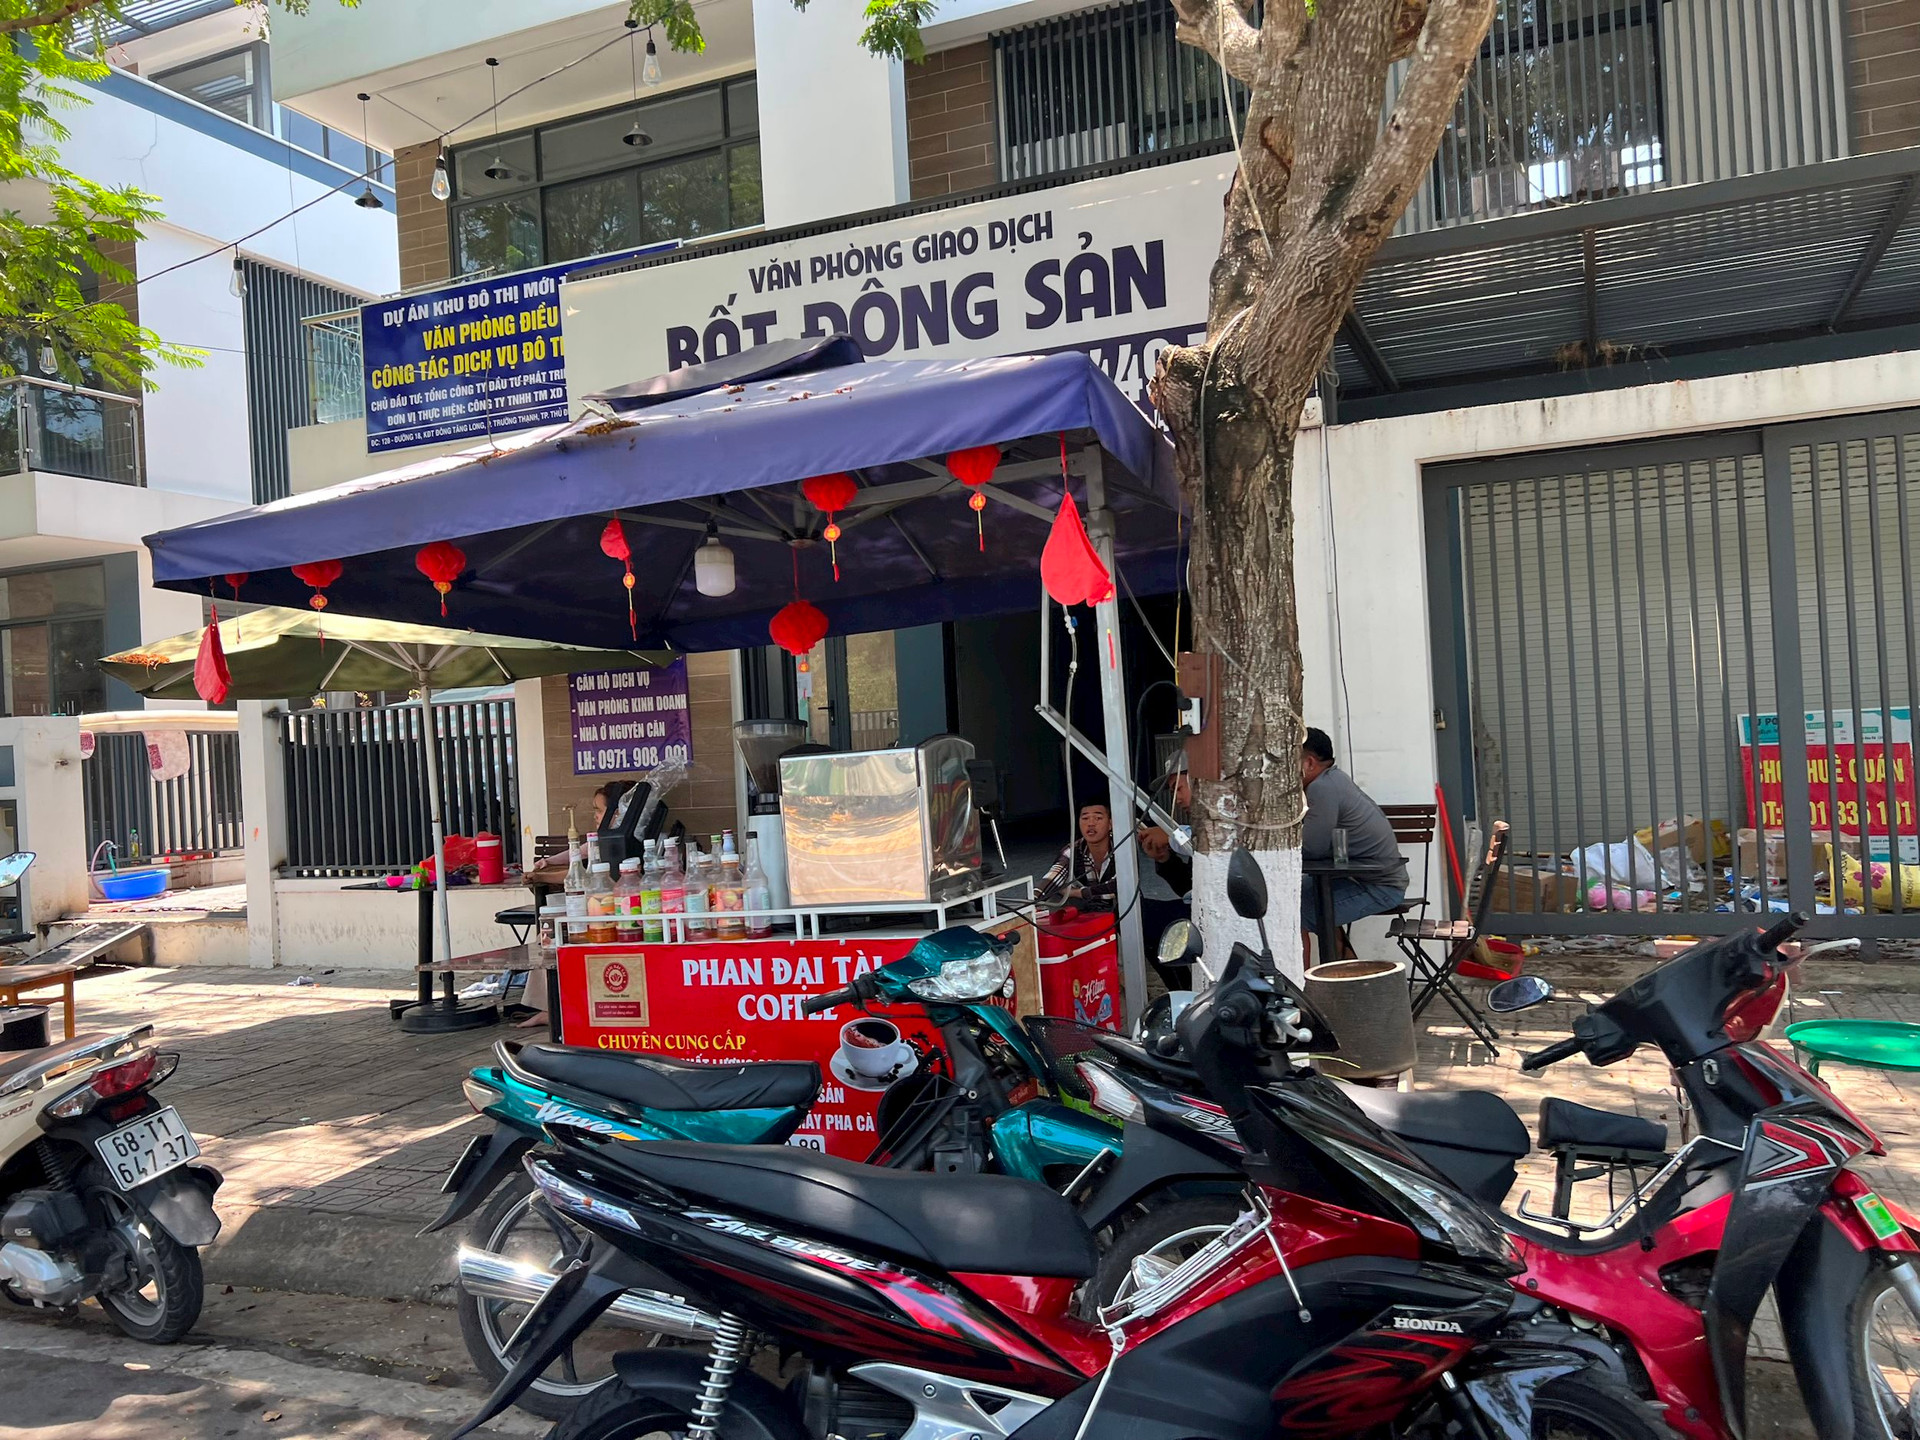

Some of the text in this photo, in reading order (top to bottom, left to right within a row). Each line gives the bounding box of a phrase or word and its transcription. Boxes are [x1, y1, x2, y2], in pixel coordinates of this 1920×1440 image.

[749, 210, 1053, 294] VĂN PHÒNG GIAO DỊCH
[383, 309, 405, 327] DỰ
[408, 300, 429, 322] ÁN
[433, 297, 464, 317] KHU
[468, 289, 489, 309] ĐÔ
[494, 285, 518, 303] THỊ
[523, 277, 555, 299] MỚI
[801, 271, 1000, 357] ĐÔNG
[1024, 230, 1166, 329] SẢN
[423, 302, 558, 350] VĂN PHÒNG ĐIỀU
[372, 364, 415, 389] CÔNG
[419, 353, 449, 381] TÁC
[453, 349, 492, 377] DỊCH
[496, 343, 518, 369] VỤ
[522, 335, 546, 363] ĐÔ
[371, 396, 388, 412] CHỦ
[409, 393, 422, 405] TƯ:
[424, 387, 448, 402] TỔNG
[450, 384, 474, 398] CÔNG
[475, 382, 487, 394] TY
[523, 371, 546, 386] PHÁT
[387, 413, 405, 426] ĐƠN
[407, 412, 416, 425] VỊ
[418, 408, 440, 421] THỰC
[442, 403, 465, 418] HIỆN:
[468, 399, 492, 414] CÔNG
[494, 397, 505, 408] TY
[507, 393, 532, 406] TNHH
[533, 390, 547, 401] TM
[550, 387, 562, 399] XD
[576, 671, 650, 692] CĂN HỘ DỊCH VỤ
[577, 694, 687, 717] VĂN PHÒNG KINH DOANH
[579, 720, 665, 742] NHÀ Ở NGUYÊN CĂN
[577, 750, 595, 770] LH:
[598, 748, 630, 769] 0971.
[633, 746, 662, 767] 908.
[682, 949, 884, 990] PHAN ĐẠI TÀI
[598, 1028, 746, 1051] CHUYÊN CUNG CẤP
[112, 1116, 171, 1157] 68-T1
[535, 1101, 623, 1134] Wave
[825, 1114, 853, 1131] PHA
[856, 1112, 875, 1132] CÀ
[118, 1134, 188, 1184] 647.37
[769, 1235, 879, 1271] BLADE
[1393, 1316, 1464, 1333] HONDA
